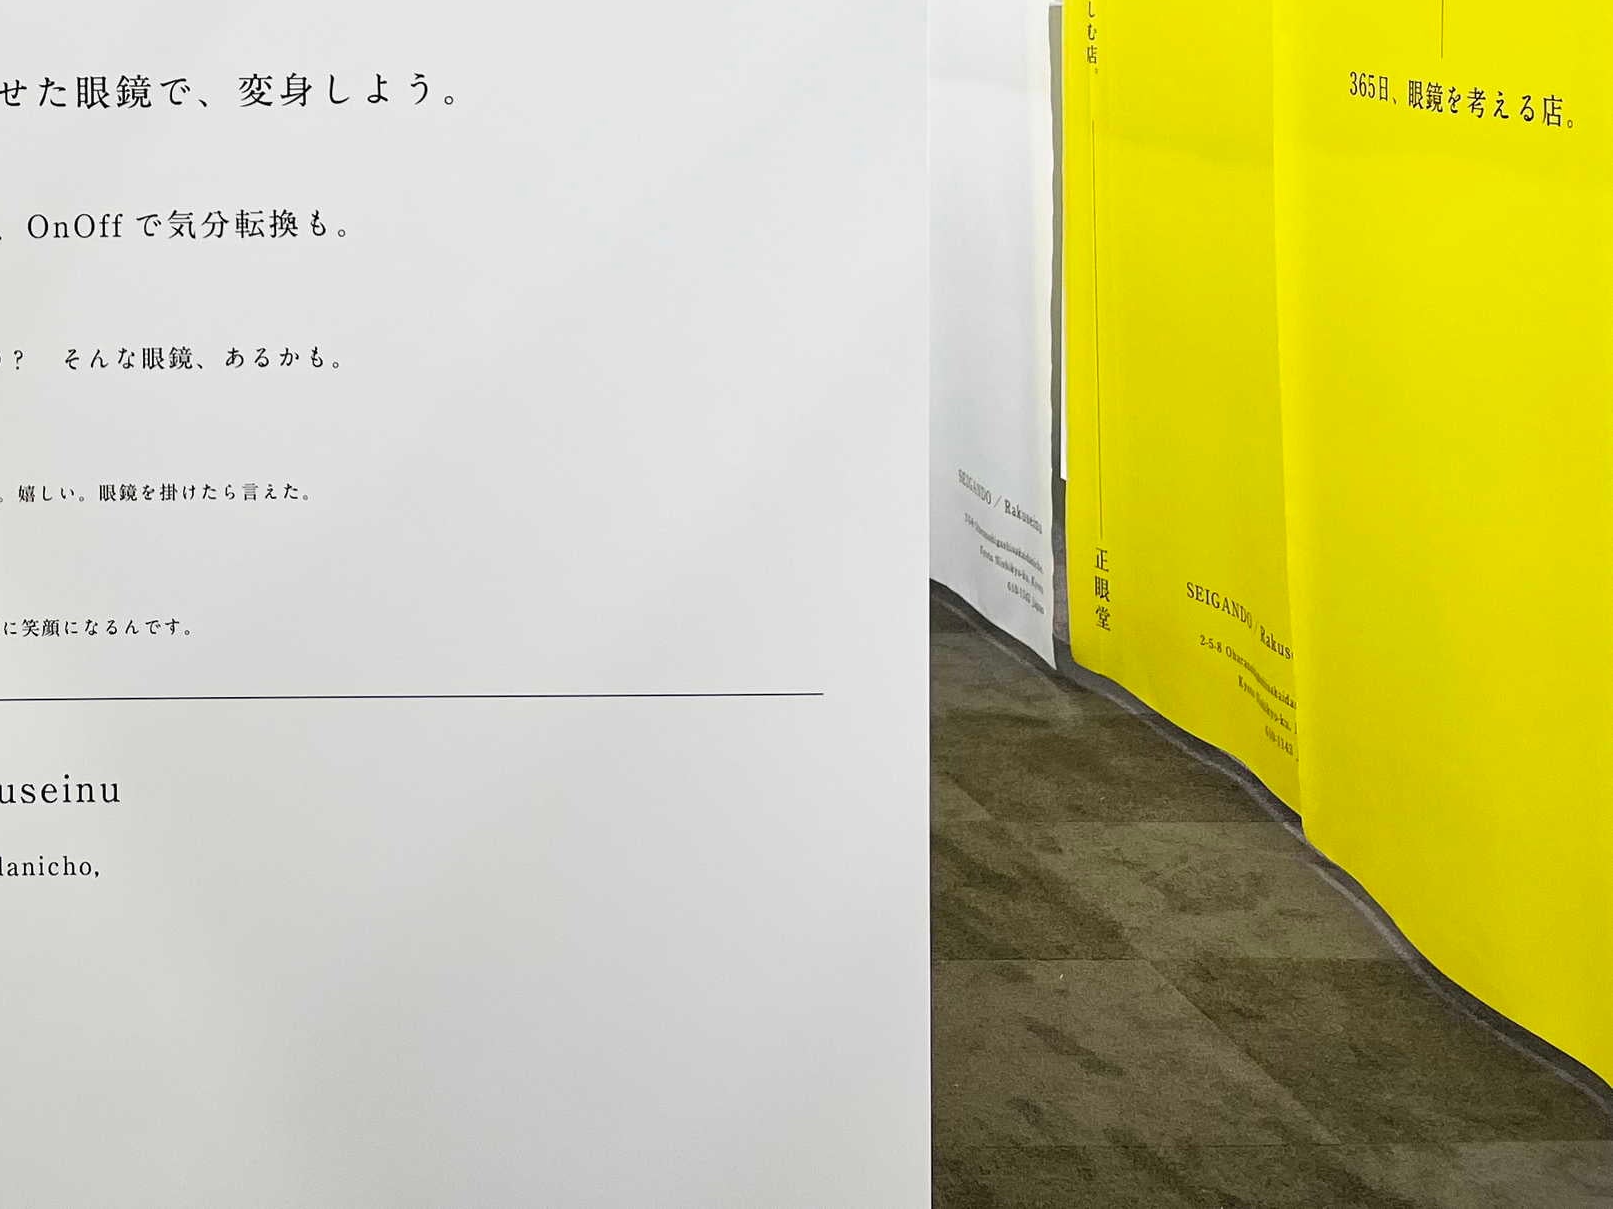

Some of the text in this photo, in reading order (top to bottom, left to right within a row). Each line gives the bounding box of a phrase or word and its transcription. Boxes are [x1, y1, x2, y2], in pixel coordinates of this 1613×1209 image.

[1094, 547, 1112, 632] 正眼堂
[1185, 580, 1254, 630] SEIGANDO
